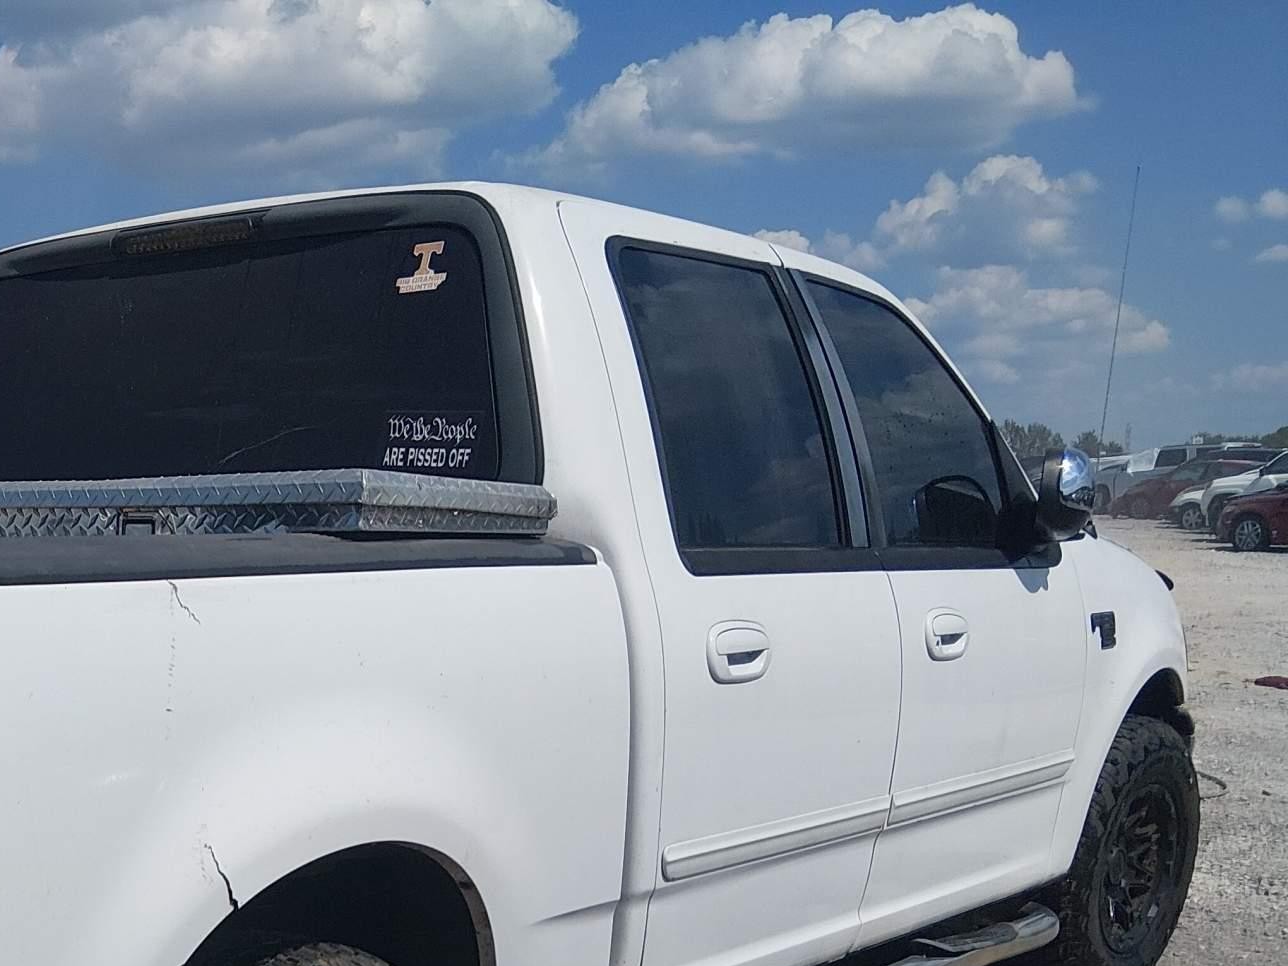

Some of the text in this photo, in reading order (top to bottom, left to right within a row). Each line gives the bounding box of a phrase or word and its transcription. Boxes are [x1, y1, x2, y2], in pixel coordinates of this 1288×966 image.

[388, 415, 409, 441] We
[429, 417, 477, 446] People
[382, 447, 472, 468] ARE PISSED OFF
